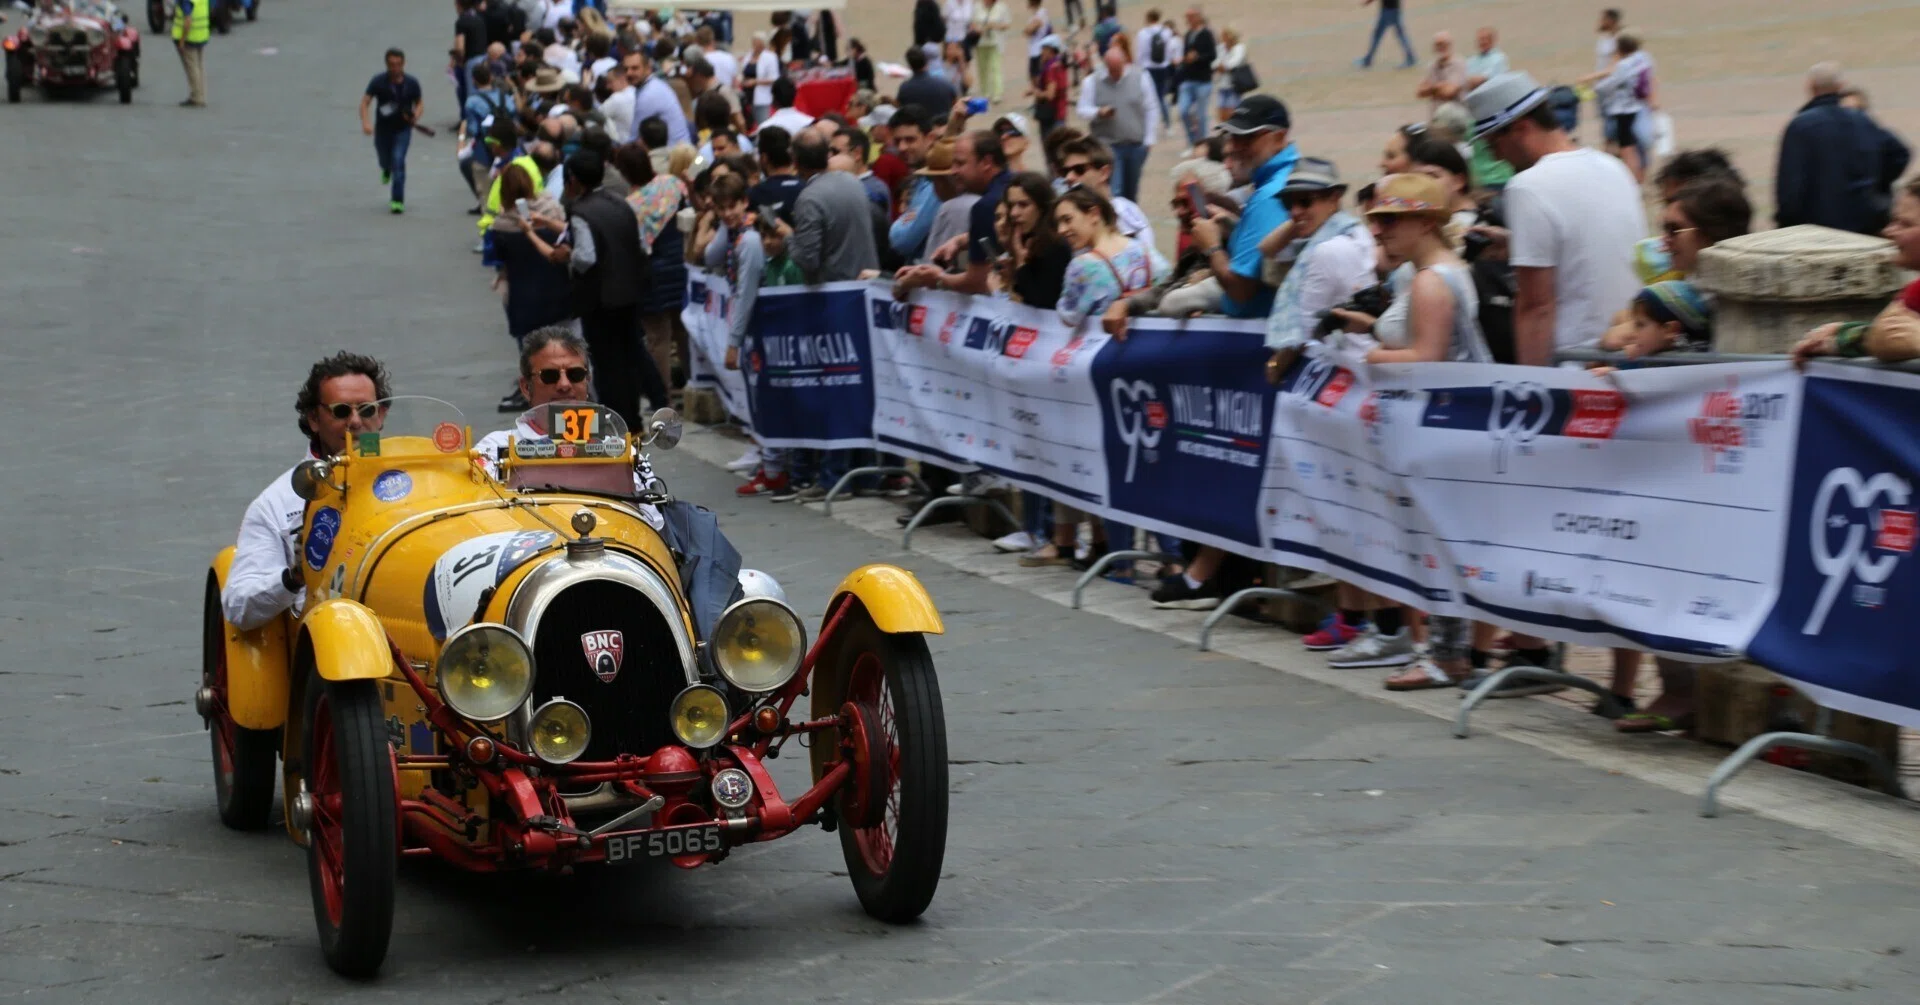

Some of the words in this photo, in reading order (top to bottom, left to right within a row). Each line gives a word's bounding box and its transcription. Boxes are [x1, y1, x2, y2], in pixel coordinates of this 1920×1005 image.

[763, 336, 796, 366] MILLE
[799, 332, 859, 365] MIGLIA
[562, 409, 595, 443] 37
[1169, 384, 1213, 427] MILLE
[1215, 388, 1262, 436] MIGLIA
[1552, 512, 1640, 540] CHOPARD
[453, 545, 500, 588] 37
[585, 633, 619, 651] BNC
[608, 835, 642, 861] BF
[648, 827, 720, 857] 5065
